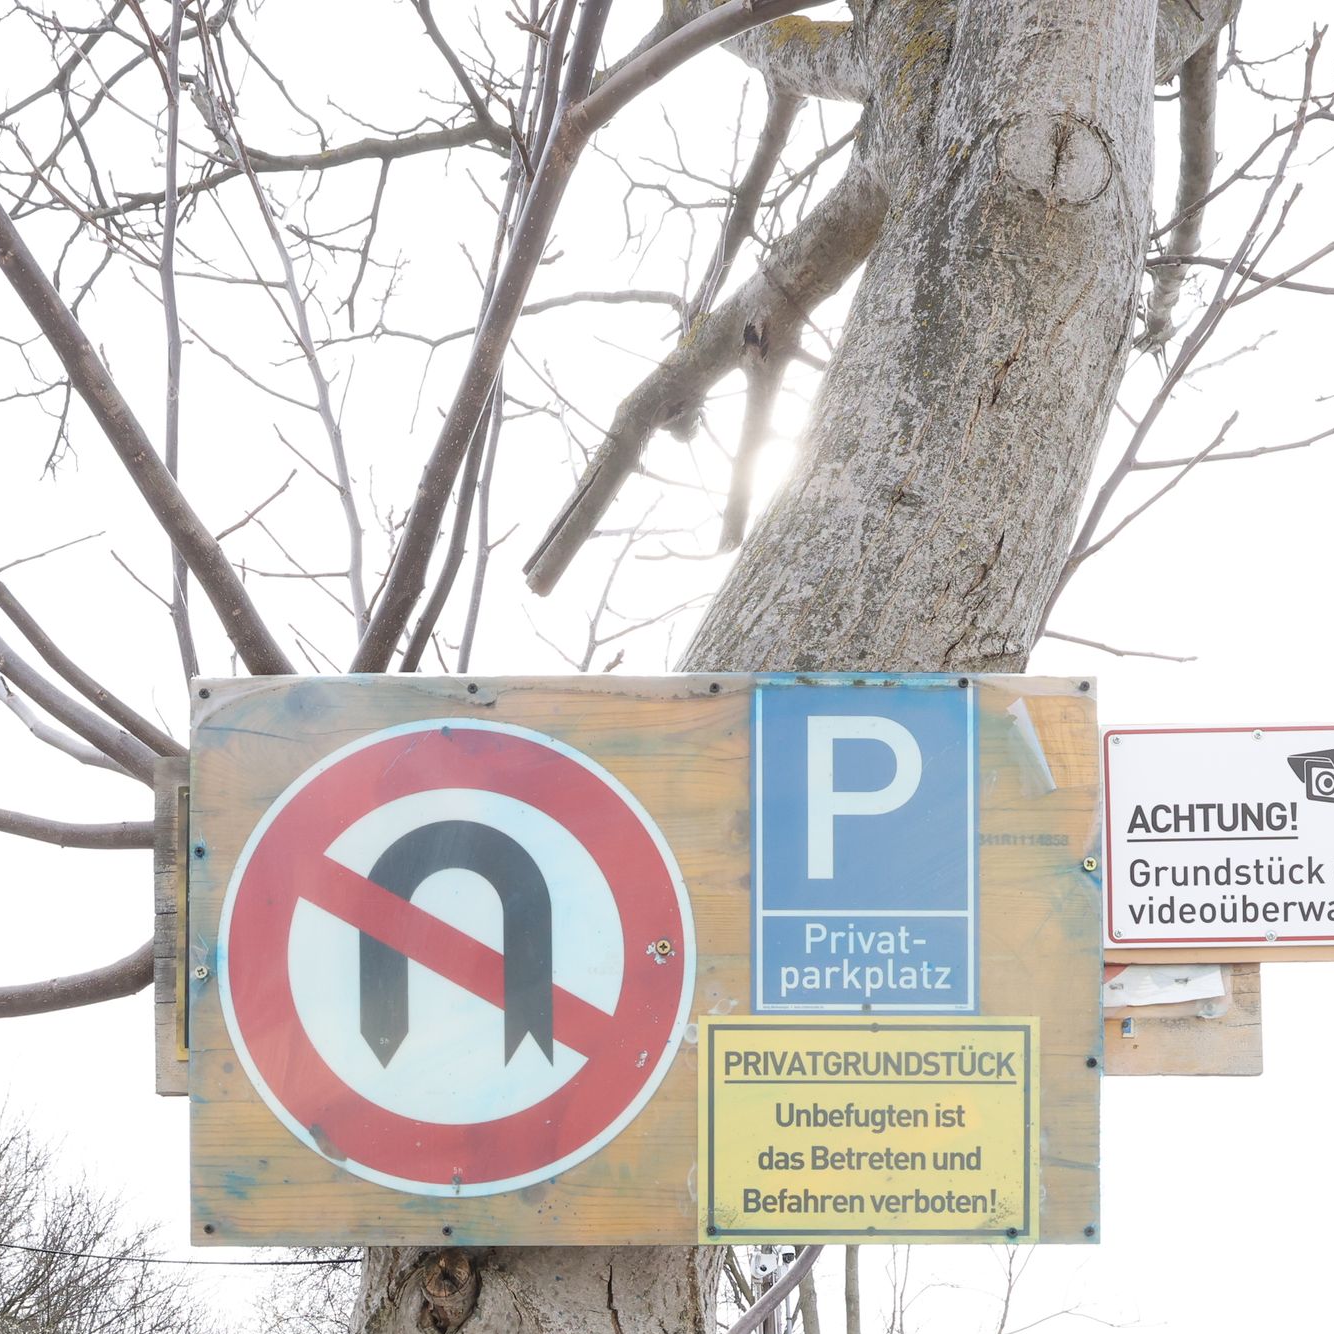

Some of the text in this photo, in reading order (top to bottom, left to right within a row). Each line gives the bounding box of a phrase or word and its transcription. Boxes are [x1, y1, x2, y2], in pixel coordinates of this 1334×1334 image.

[808, 716, 922, 879] P
[1127, 802, 1298, 833] ACHTUNG!
[1129, 855, 1327, 887] Grundstück
[804, 922, 927, 955] Privat-
[780, 957, 951, 997] parkplatz
[724, 1044, 1016, 1077] PRIVATGRUNDSTÜCK
[775, 1102, 966, 1133] Unbefugten ist
[758, 1146, 982, 1171] das Betreten und
[743, 1188, 998, 1214] Befahren verboten!
